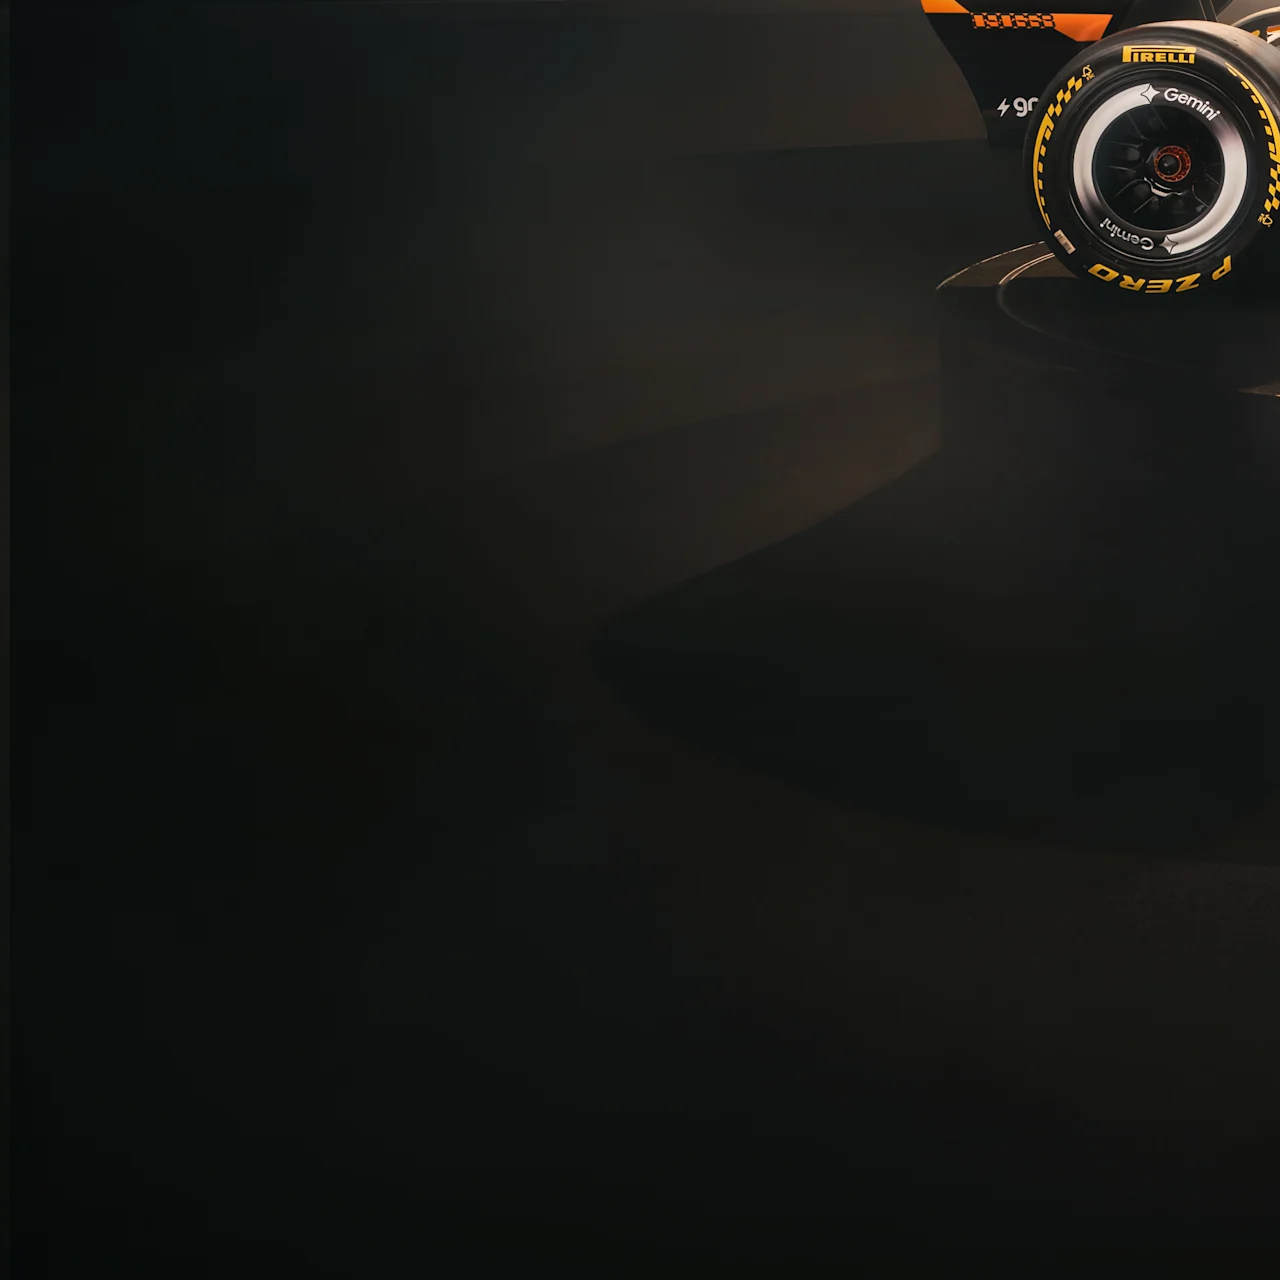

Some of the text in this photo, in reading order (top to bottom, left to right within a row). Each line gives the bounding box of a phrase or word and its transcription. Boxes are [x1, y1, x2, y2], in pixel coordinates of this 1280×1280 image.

[1122, 44, 1196, 65] PIRELLI
[1163, 87, 1221, 121] Gemini
[1099, 217, 1154, 251] Gemini
[1088, 255, 1232, 294] P ZERO
